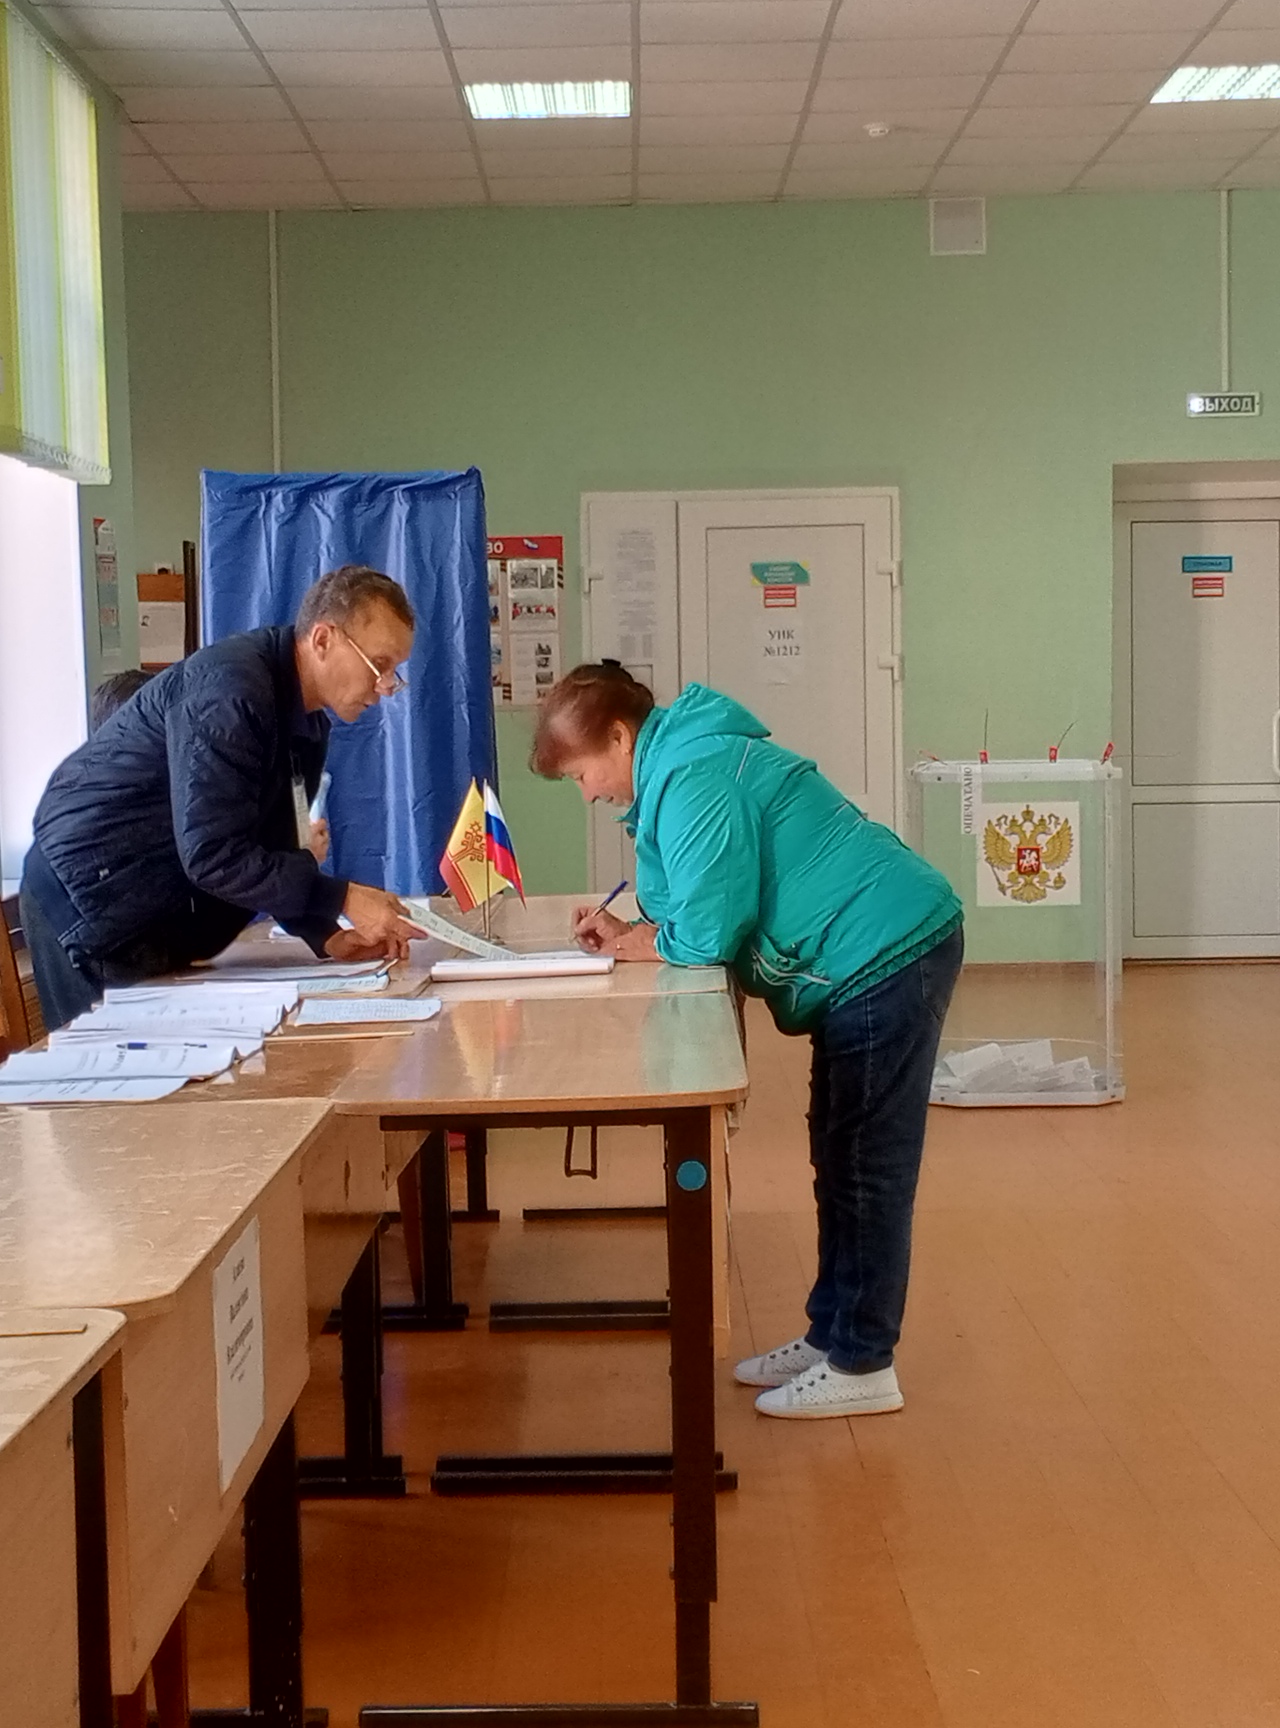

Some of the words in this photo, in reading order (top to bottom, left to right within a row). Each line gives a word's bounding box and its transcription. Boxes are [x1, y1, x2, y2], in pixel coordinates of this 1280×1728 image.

[1194, 397, 1253, 412] ВЫХОД
[768, 629, 795, 640] УИК
[963, 766, 973, 834] ОПЕЧАТАНО
